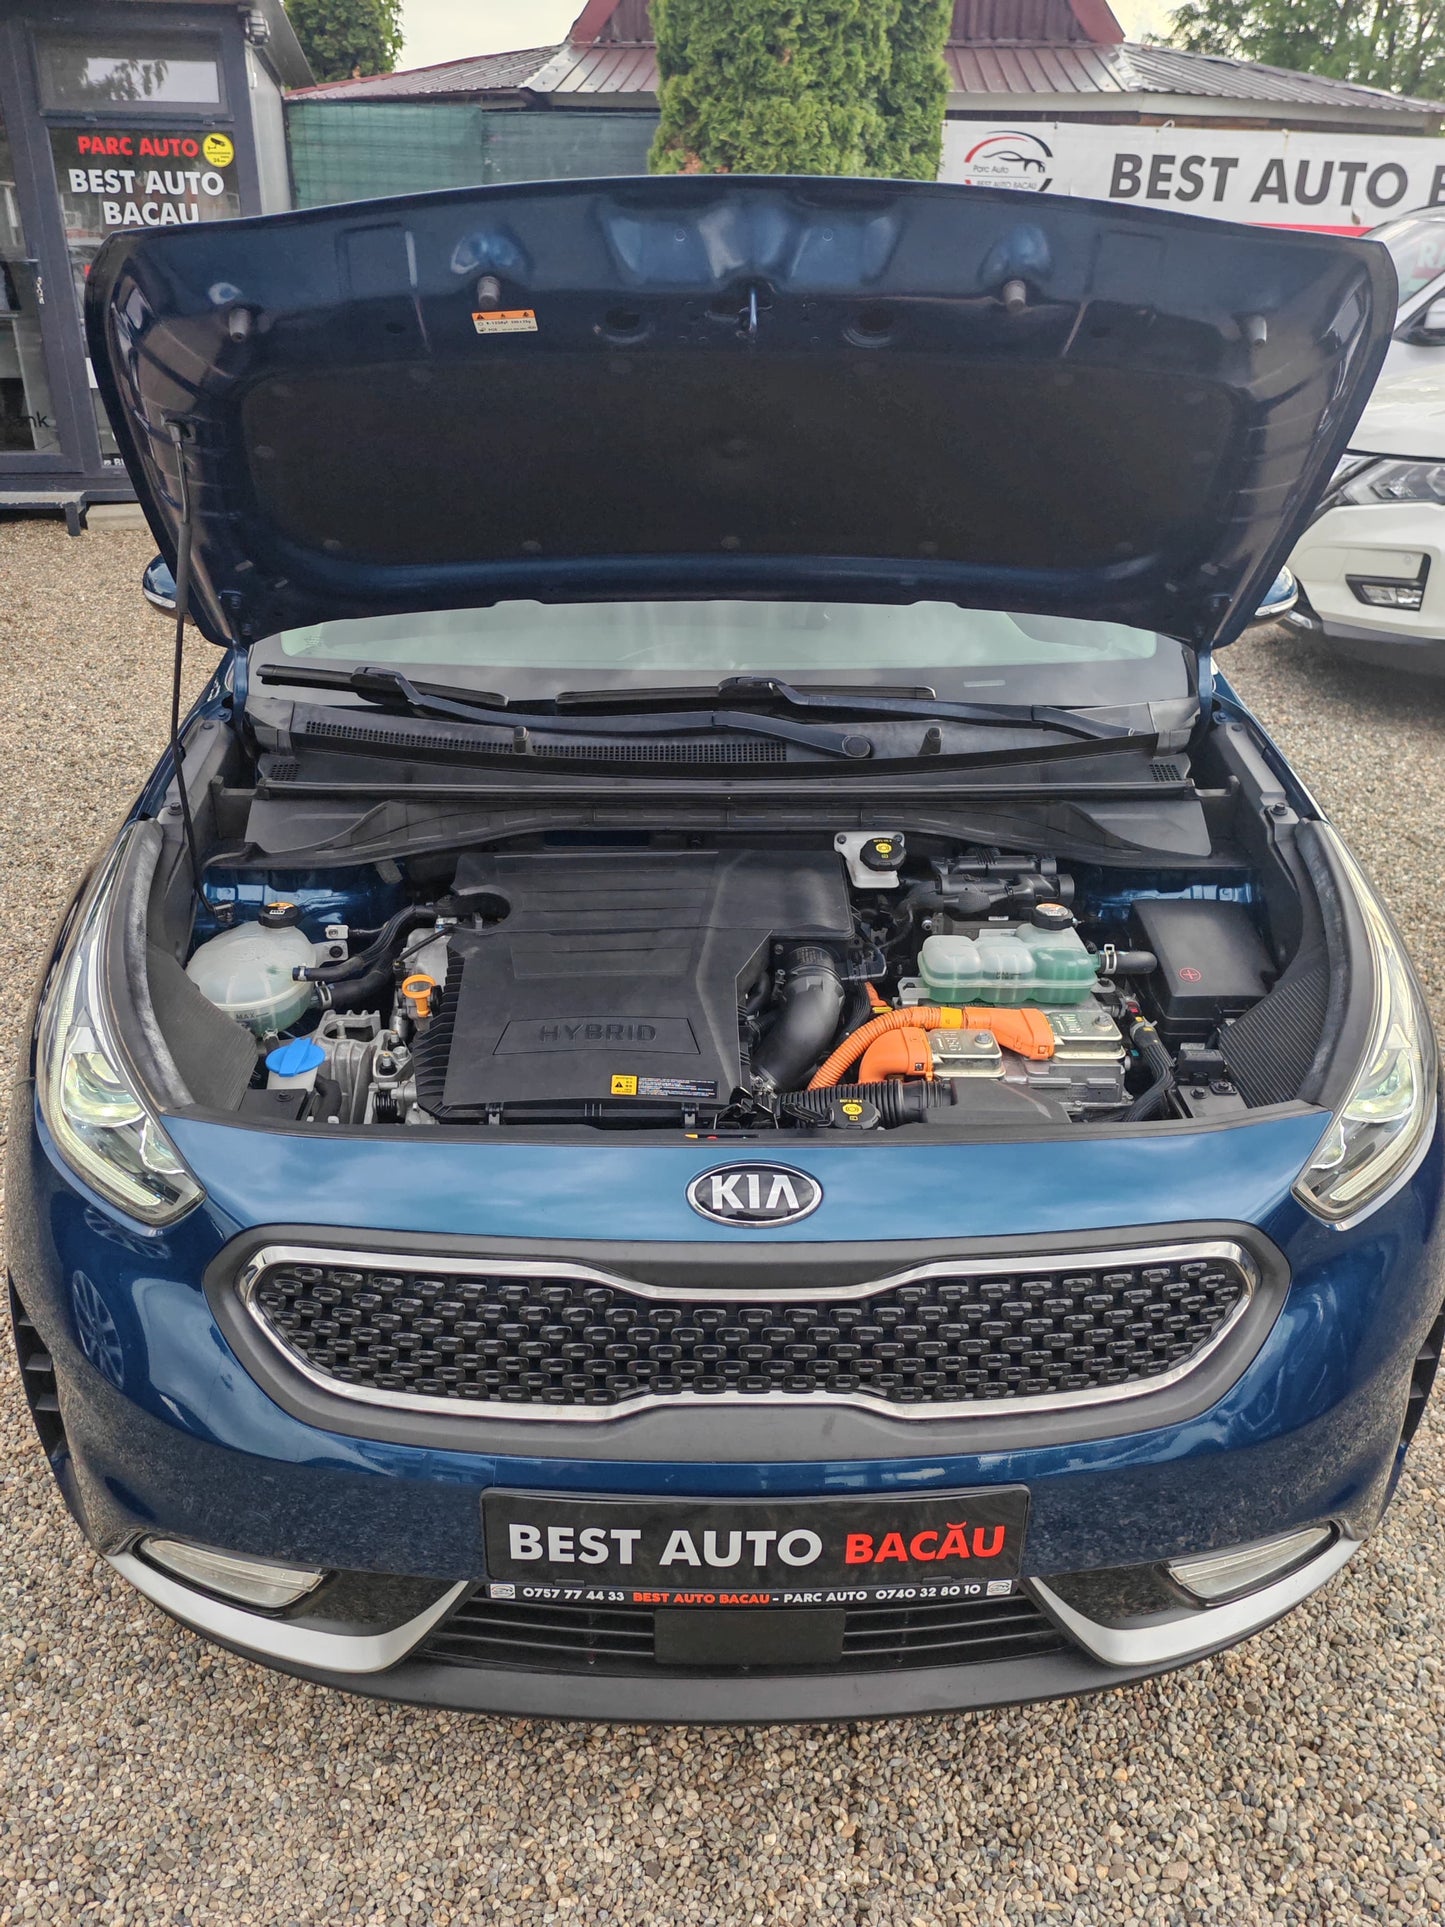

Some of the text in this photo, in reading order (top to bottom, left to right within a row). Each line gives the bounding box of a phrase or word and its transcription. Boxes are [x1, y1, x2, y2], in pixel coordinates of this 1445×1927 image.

[78, 136, 134, 156] PARC
[139, 137, 200, 158] AUTO
[68, 168, 225, 196] BEST AUTO
[973, 165, 1009, 174] Parc Auto
[1108, 153, 1240, 202] BEST
[1250, 158, 1409, 209] AUTO
[102, 201, 200, 226] BACAU
[539, 1023, 657, 1042] HYBRID
[709, 1173, 800, 1210] KIA
[508, 1521, 1007, 1567] BEST AUTO BACĂU
[522, 1587, 560, 1599] 0757
[564, 1588, 583, 1600] 77
[586, 1590, 604, 1601] 44
[608, 1591, 625, 1601] 33
[632, 1592, 670, 1603] BEST
[673, 1592, 716, 1604] AUTO
[719, 1593, 771, 1605] BACAU
[784, 1592, 822, 1604] PARC
[826, 1590, 868, 1602] AUTO
[875, 1588, 916, 1600] 0740
[919, 1586, 937, 1598] 32
[940, 1585, 959, 1597] 80
[963, 1584, 981, 1596] 10
